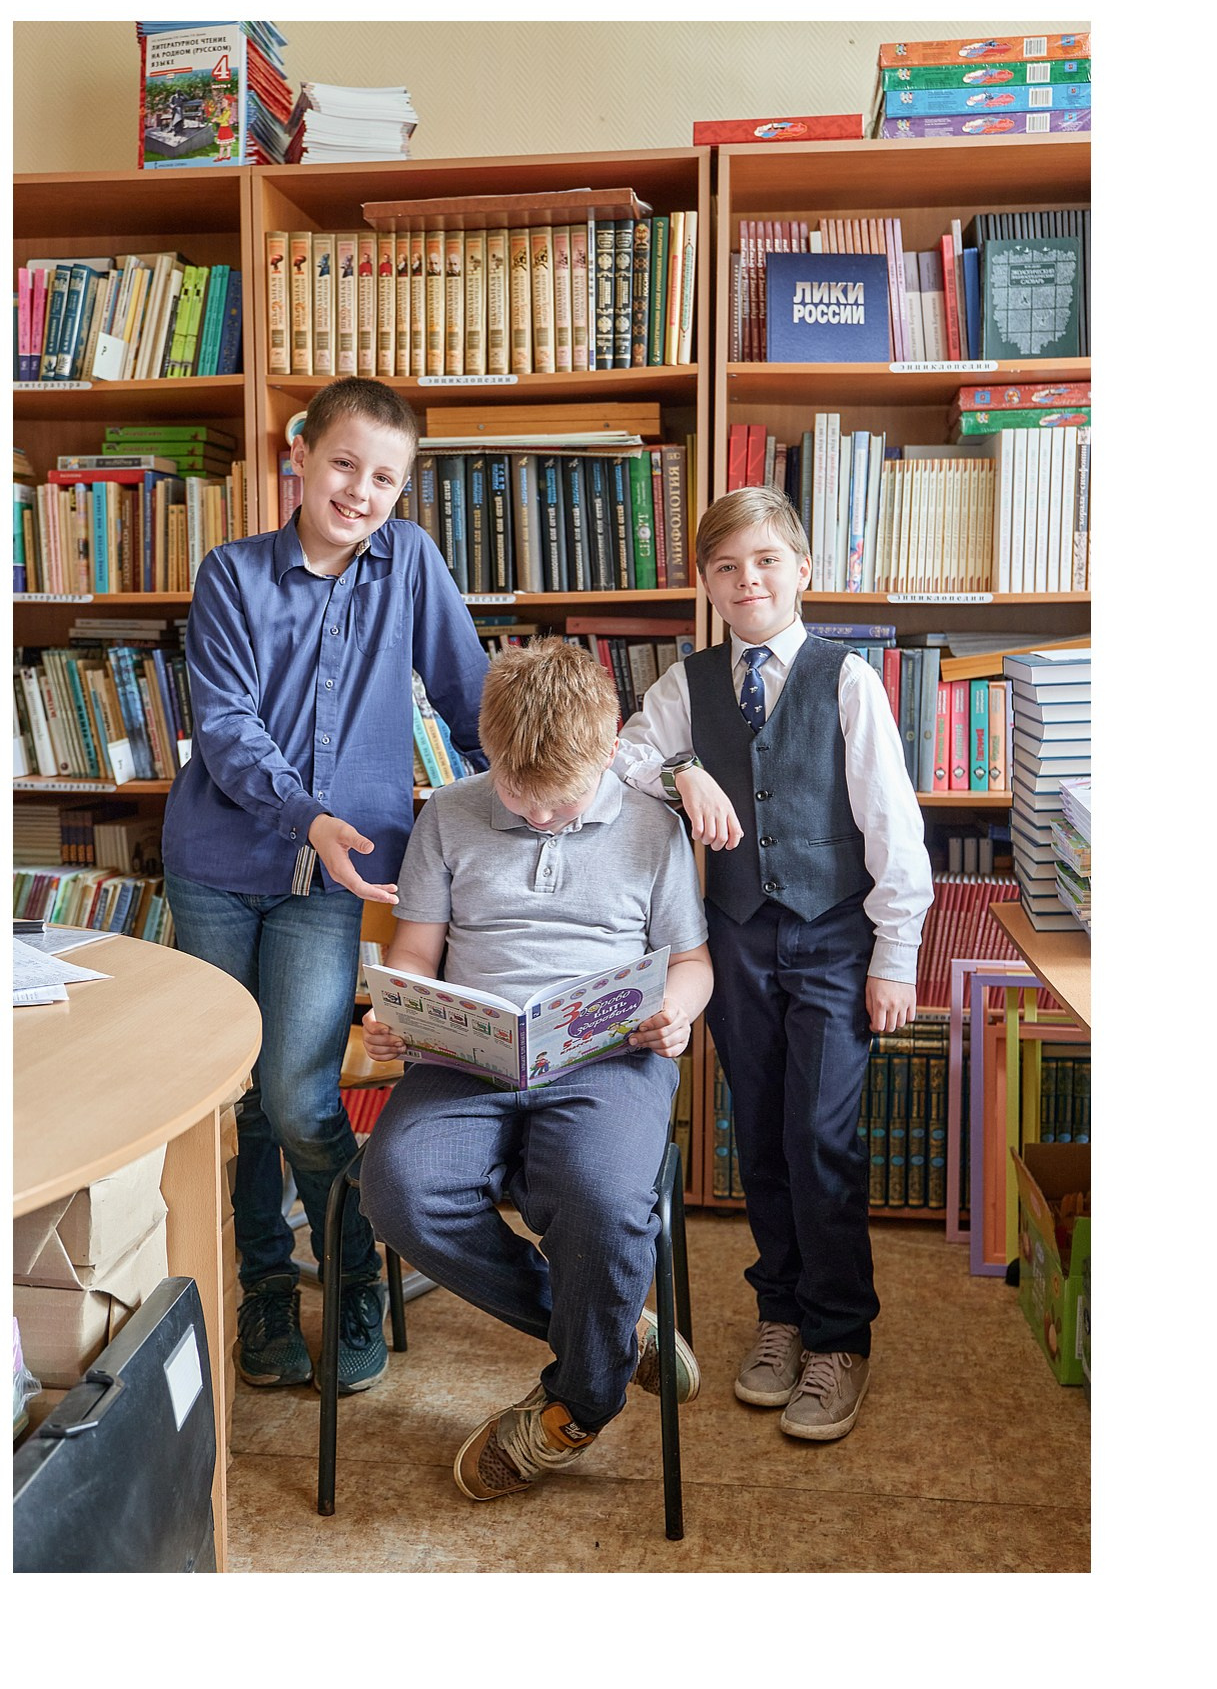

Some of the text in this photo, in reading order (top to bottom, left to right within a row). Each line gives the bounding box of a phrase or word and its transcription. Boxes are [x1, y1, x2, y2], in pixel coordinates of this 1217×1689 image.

[211, 54, 231, 81] 4
[793, 281, 864, 305] ЛИКИ
[793, 305, 865, 325] РОССИИ
[667, 465, 683, 565] МИФОЛОГИЯ
